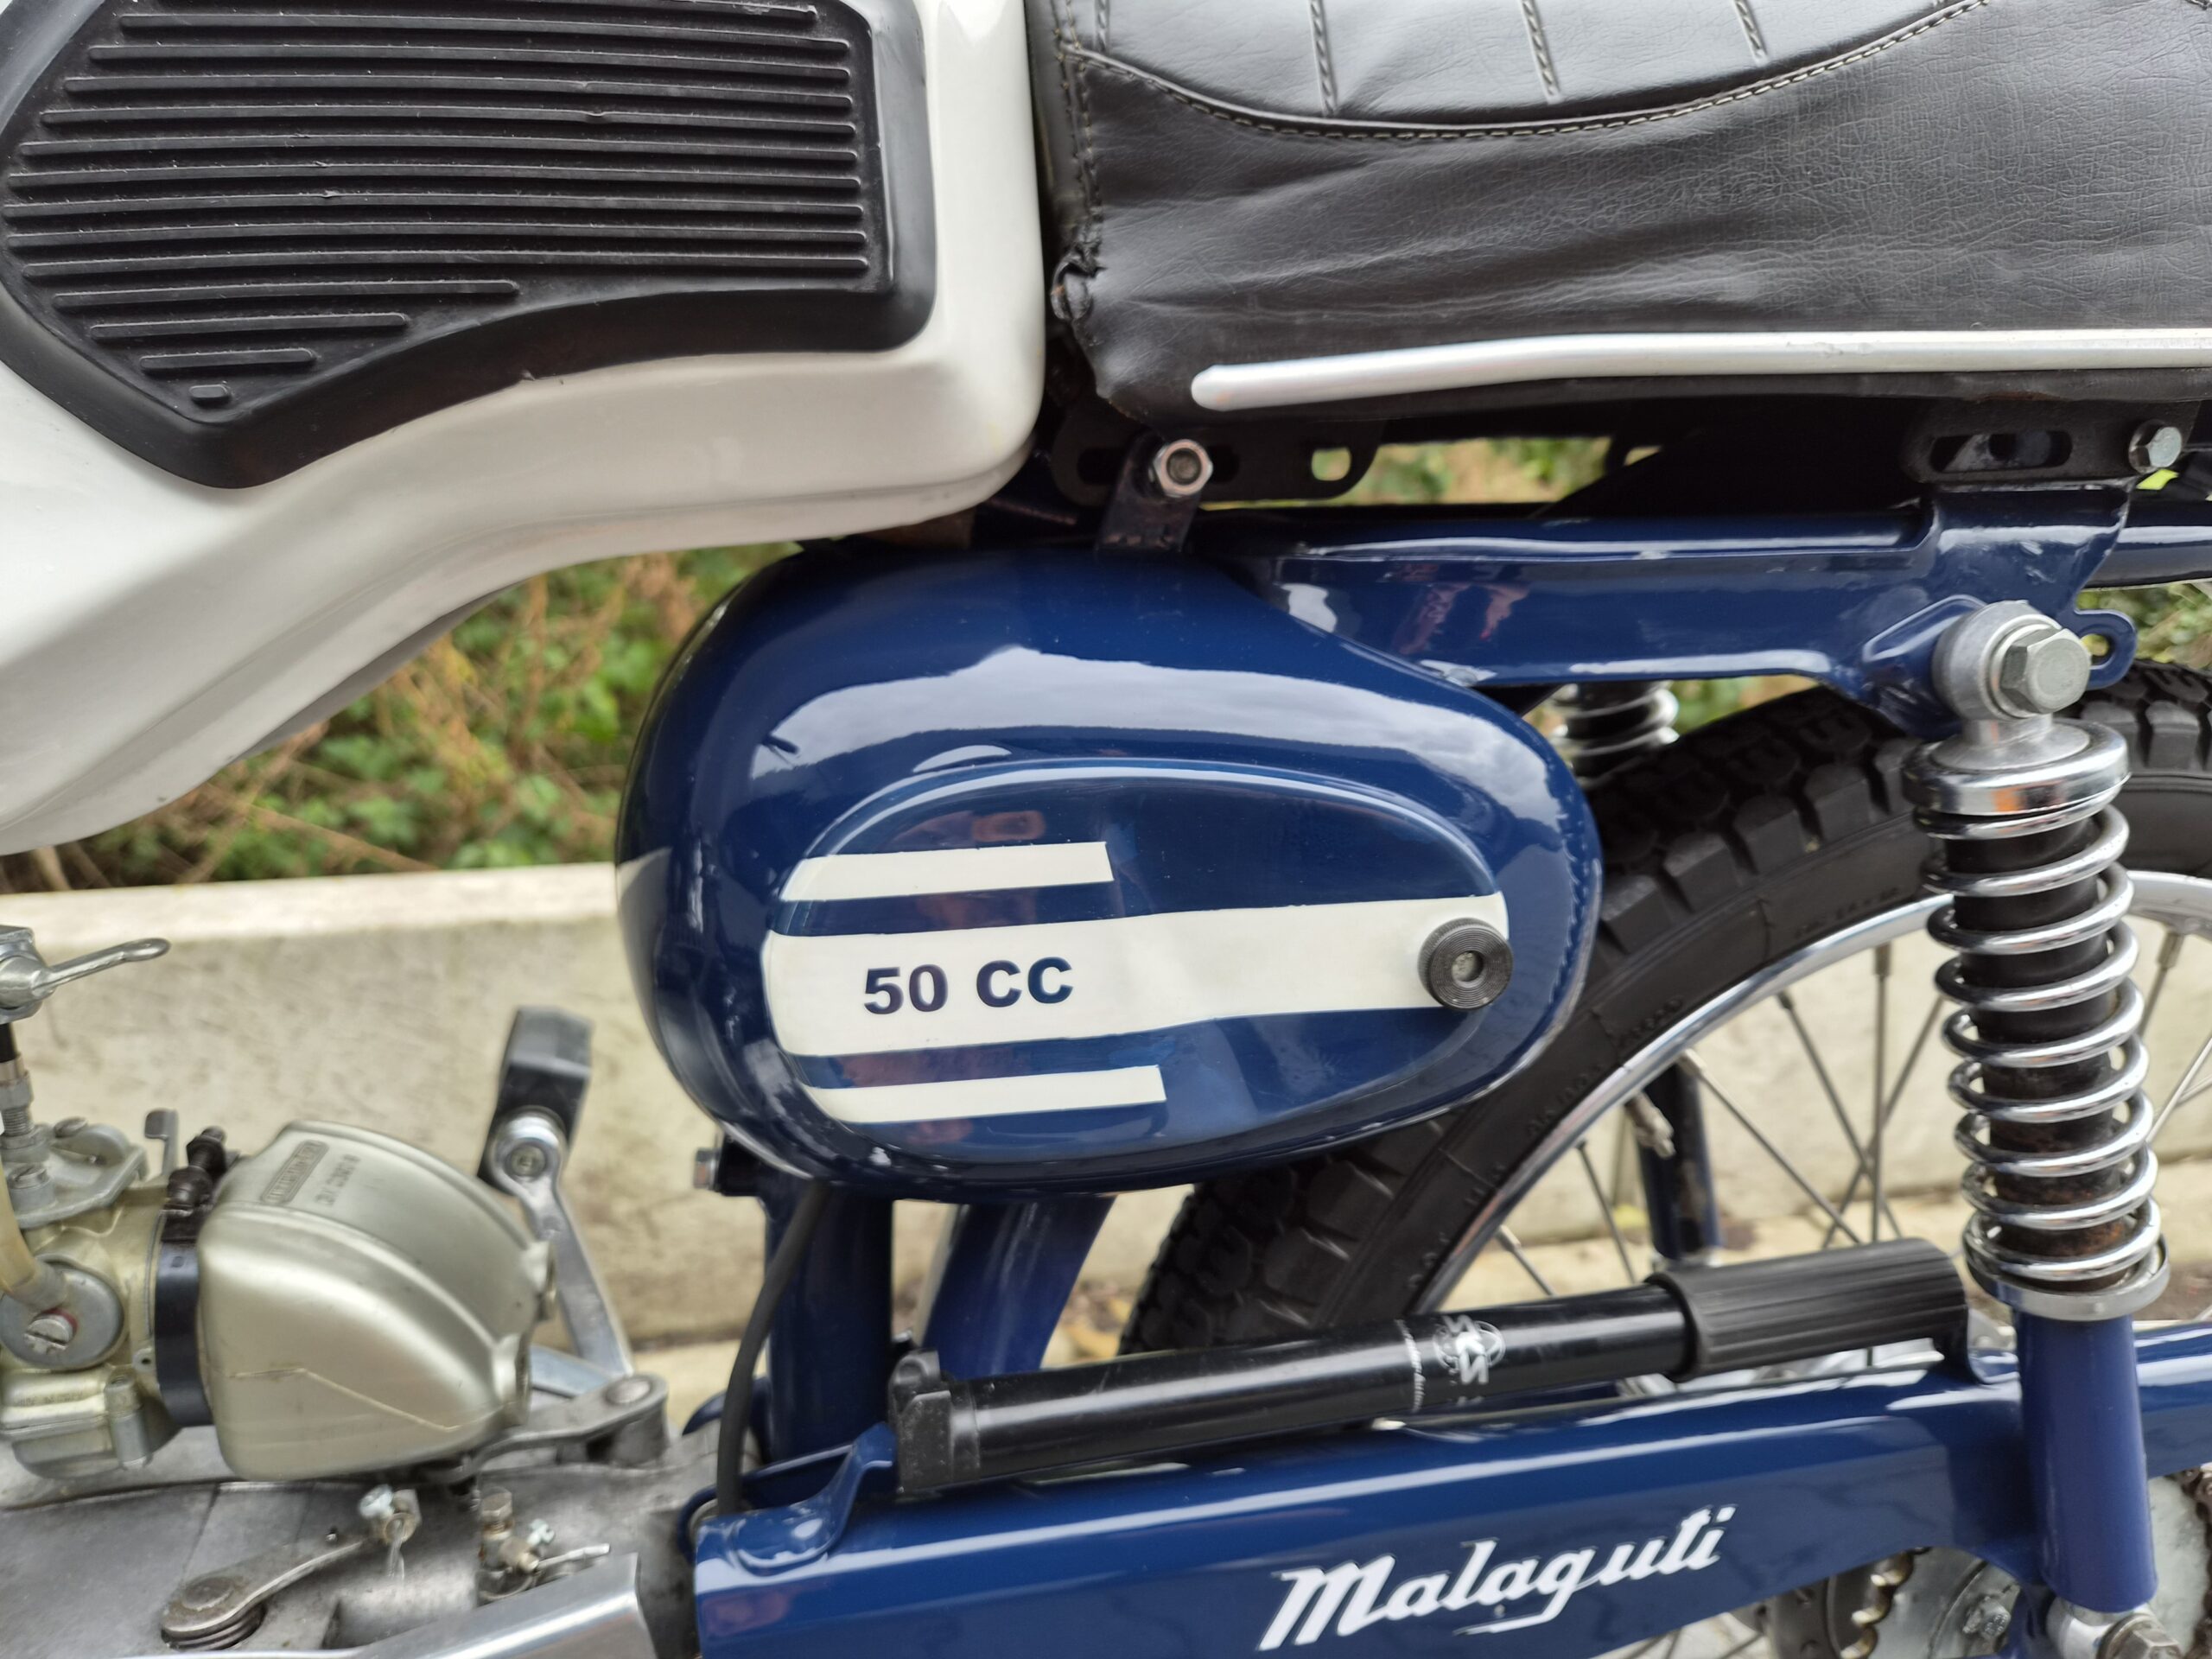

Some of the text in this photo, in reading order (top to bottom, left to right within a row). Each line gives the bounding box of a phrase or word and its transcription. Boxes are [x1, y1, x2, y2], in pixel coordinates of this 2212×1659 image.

[864, 956, 1074, 1015] 50 CC
[1257, 1503, 1739, 1652] Malaguti
